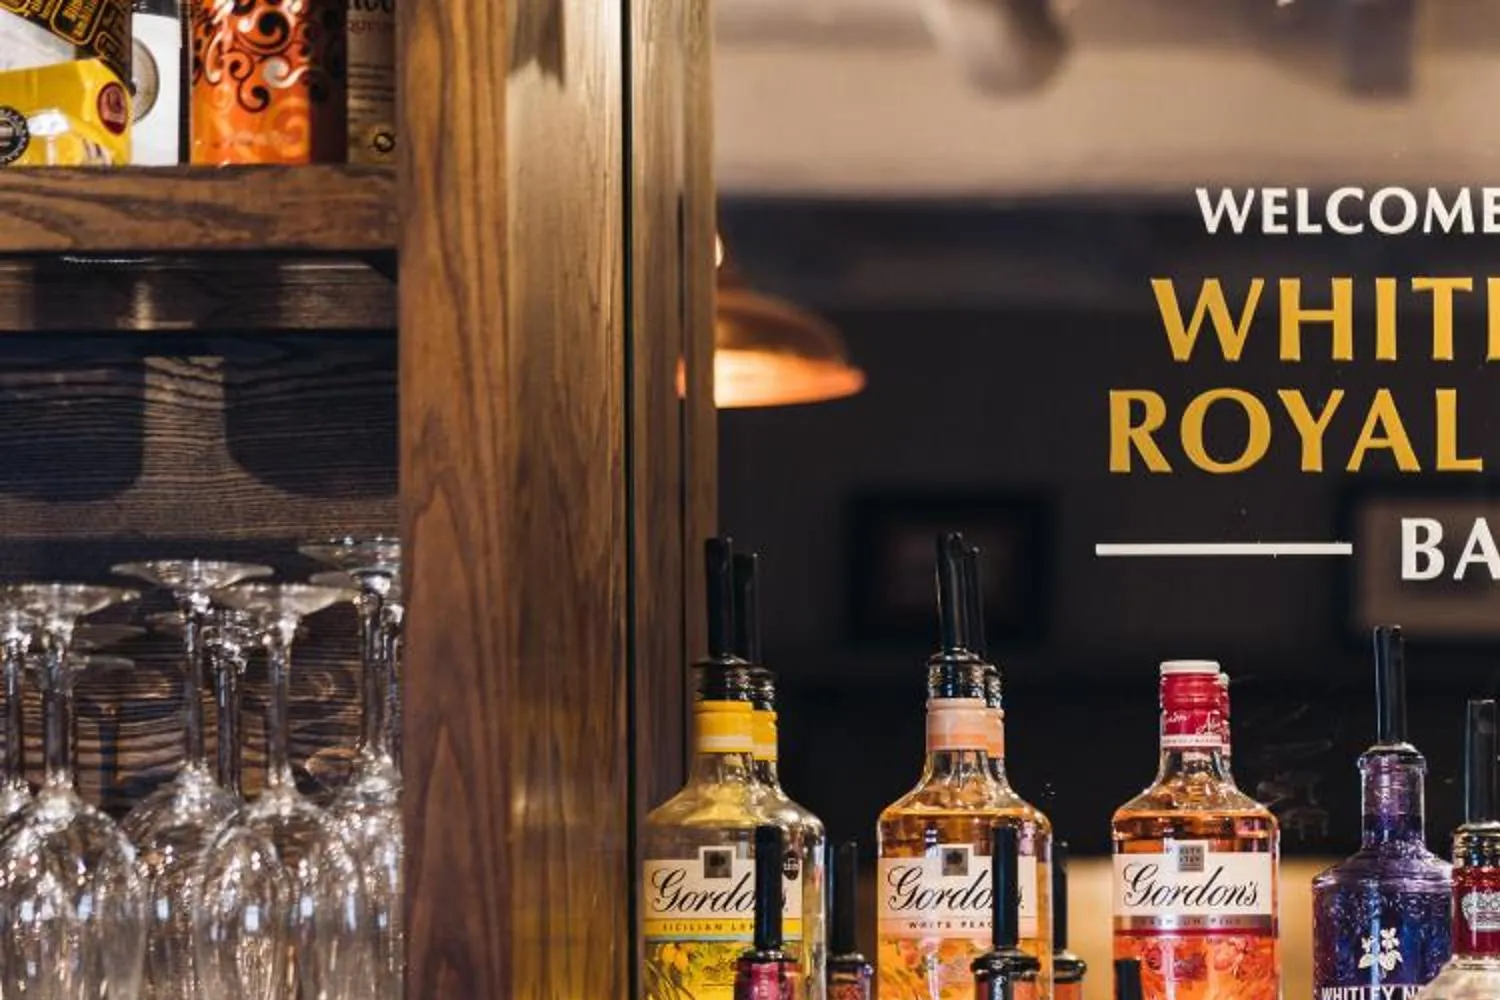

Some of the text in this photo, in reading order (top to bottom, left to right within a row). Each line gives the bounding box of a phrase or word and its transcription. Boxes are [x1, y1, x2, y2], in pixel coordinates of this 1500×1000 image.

[1107, 388, 1485, 474] ROYAL
[651, 867, 788, 913] Gordo
[887, 865, 1023, 912] Gordo
[1123, 863, 1258, 907] Gordon's
[960, 921, 993, 930] PEAC
